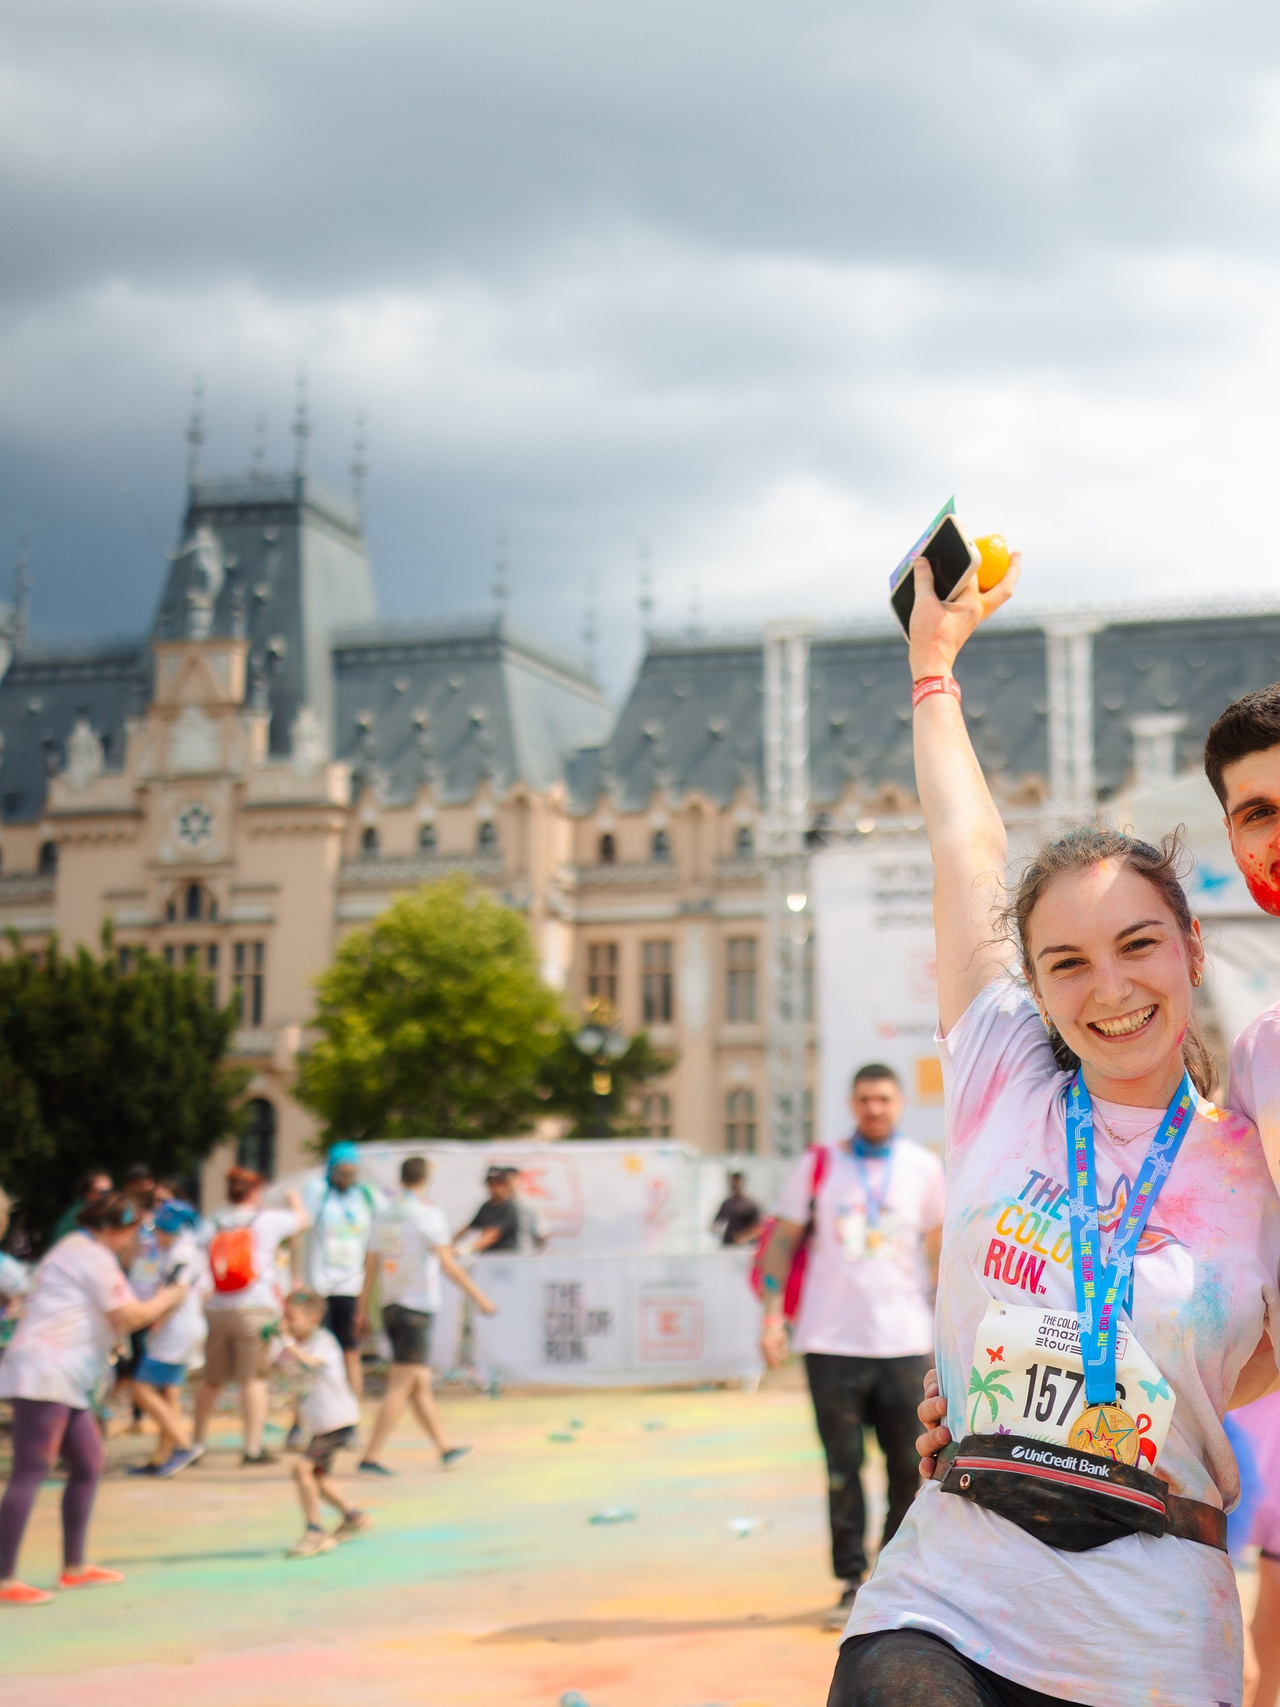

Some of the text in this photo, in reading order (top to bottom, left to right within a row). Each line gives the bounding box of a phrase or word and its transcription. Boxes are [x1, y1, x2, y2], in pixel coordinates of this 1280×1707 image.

[1165, 1094, 1191, 1139] THE COLOR RUN
[1075, 1137, 1088, 1187] THE COLOR RUN
[1018, 1169, 1070, 1221] THE
[1125, 1181, 1154, 1229] THE COLOR RUN
[996, 1205, 1073, 1271] COLO
[1080, 1241, 1096, 1299] THE COLOR RUN
[1042, 1315, 1057, 1326] THE
[1097, 1288, 1118, 1347] THE COLOR RUN
[1024, 1448, 1110, 1478] UniCredit Bank
